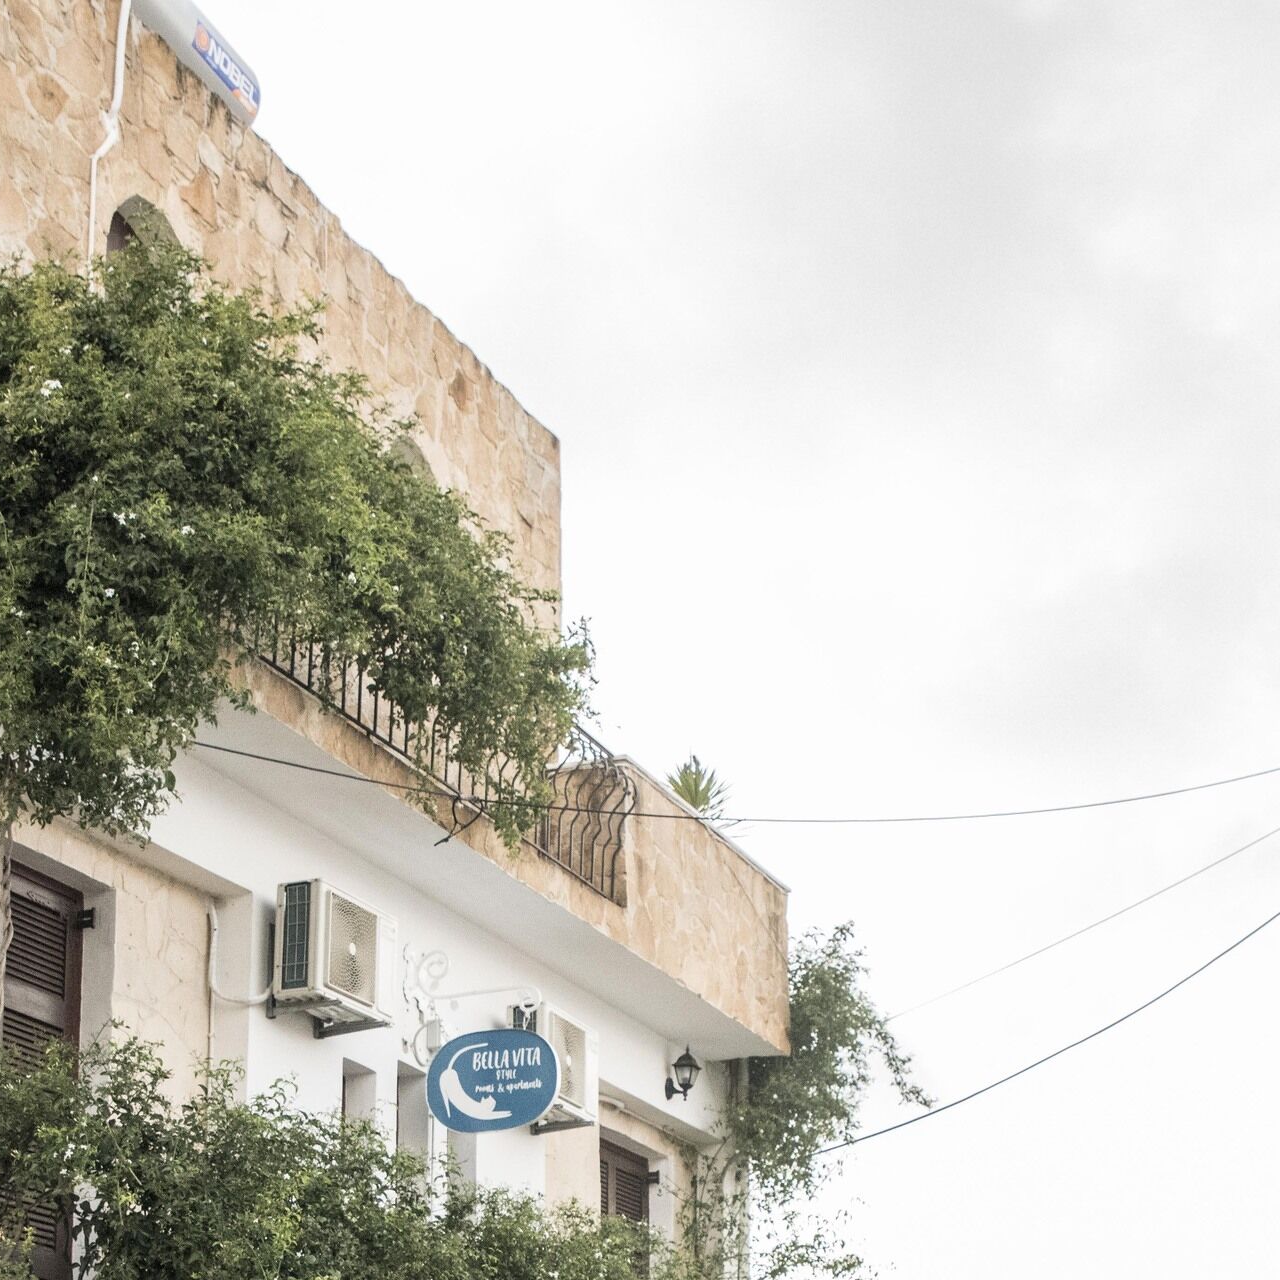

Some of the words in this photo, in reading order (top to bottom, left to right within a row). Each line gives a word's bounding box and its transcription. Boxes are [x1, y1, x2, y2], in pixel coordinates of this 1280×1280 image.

[208, 37, 257, 108] NOBEL
[472, 1049, 510, 1072] BELLA
[512, 1046, 541, 1067] VITA
[496, 1069, 517, 1080] STYLE
[475, 1084, 494, 1093] rooms
[497, 1083, 505, 1093] &
[506, 1077, 542, 1094] apartments
